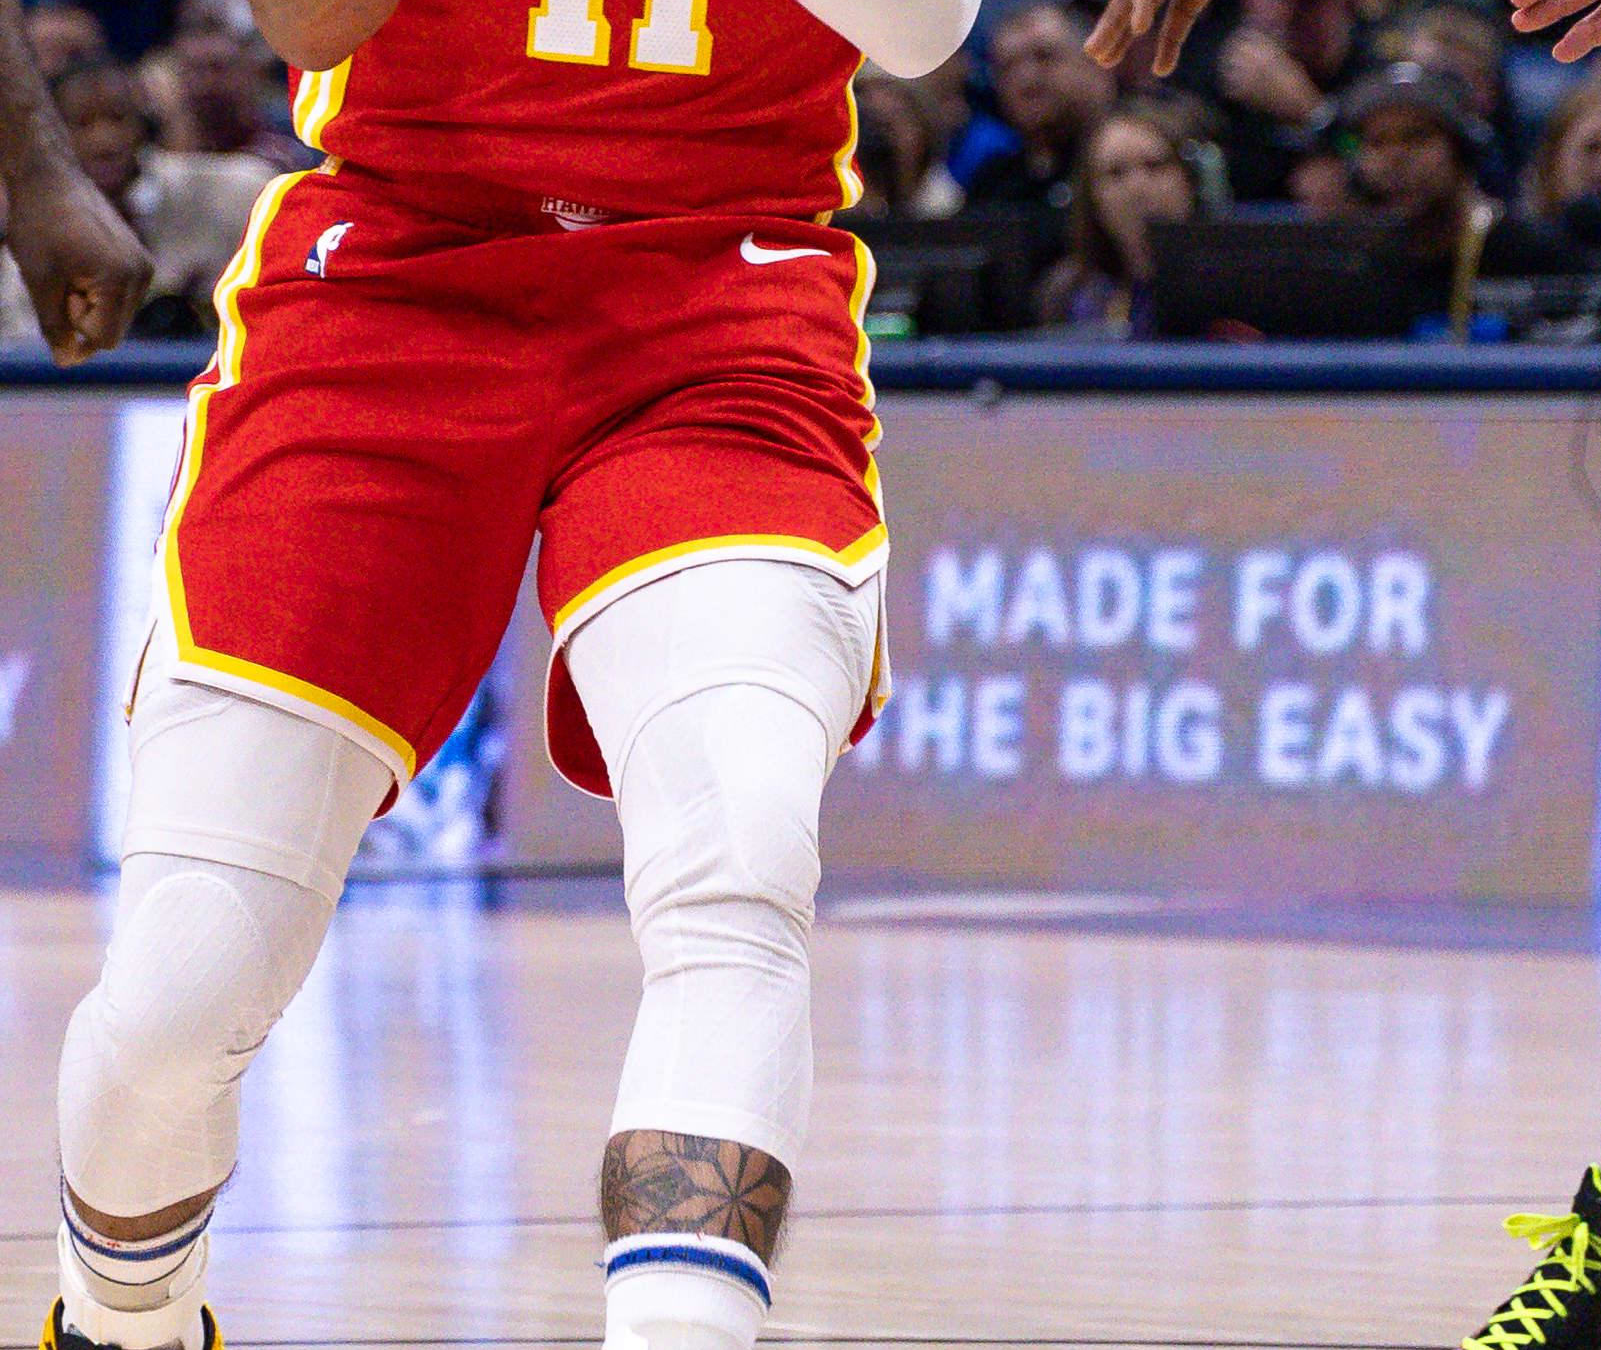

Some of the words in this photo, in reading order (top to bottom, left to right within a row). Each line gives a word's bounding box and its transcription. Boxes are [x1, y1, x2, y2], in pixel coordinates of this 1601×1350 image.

[926, 545, 1200, 650] MADE
[1234, 548, 1429, 655] FOR
[1058, 678, 1222, 784] BIG
[1258, 684, 1505, 792] EASY
